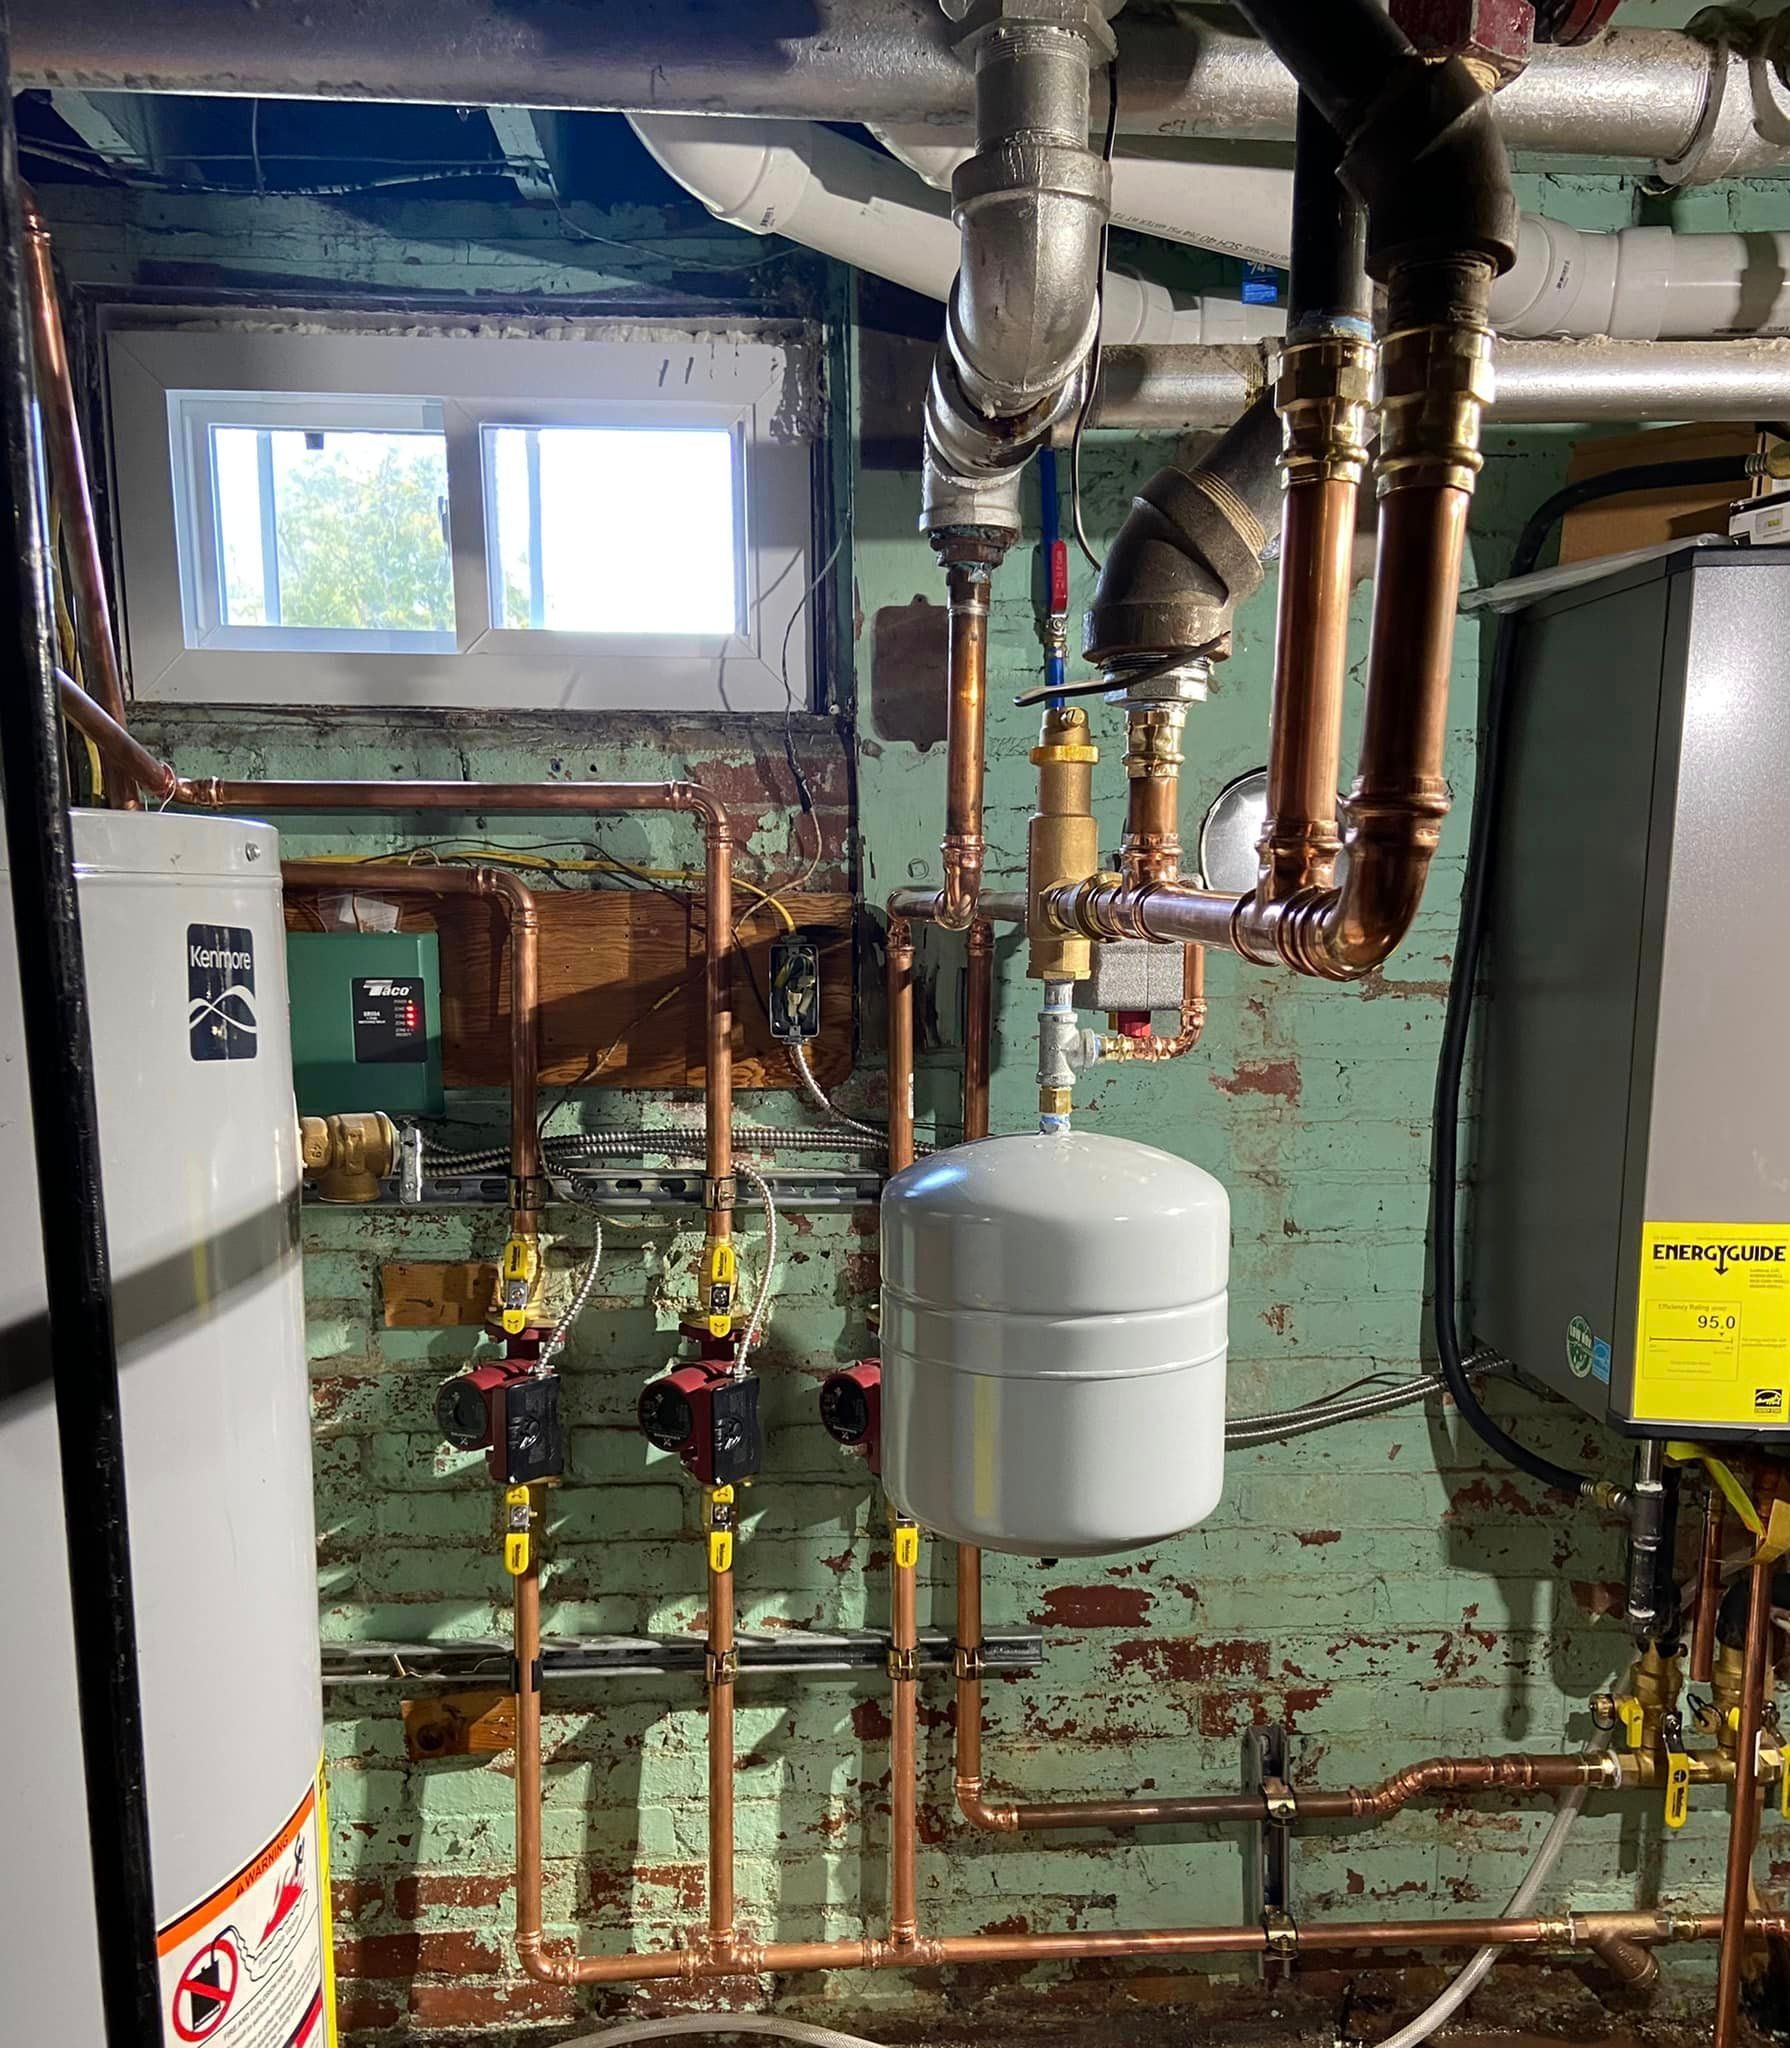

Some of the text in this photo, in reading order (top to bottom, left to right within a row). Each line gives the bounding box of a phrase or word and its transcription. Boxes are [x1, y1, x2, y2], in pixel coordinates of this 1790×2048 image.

[1201, 235, 1217, 243] 40
[1218, 238, 1242, 250] SCH
[190, 944, 251, 970] Kenmore
[363, 980, 410, 996] Taco
[1653, 1244, 1786, 1266] ENERGYGUIDE
[1698, 1314, 1736, 1329] 95.0
[245, 1834, 288, 1888] WARNING
